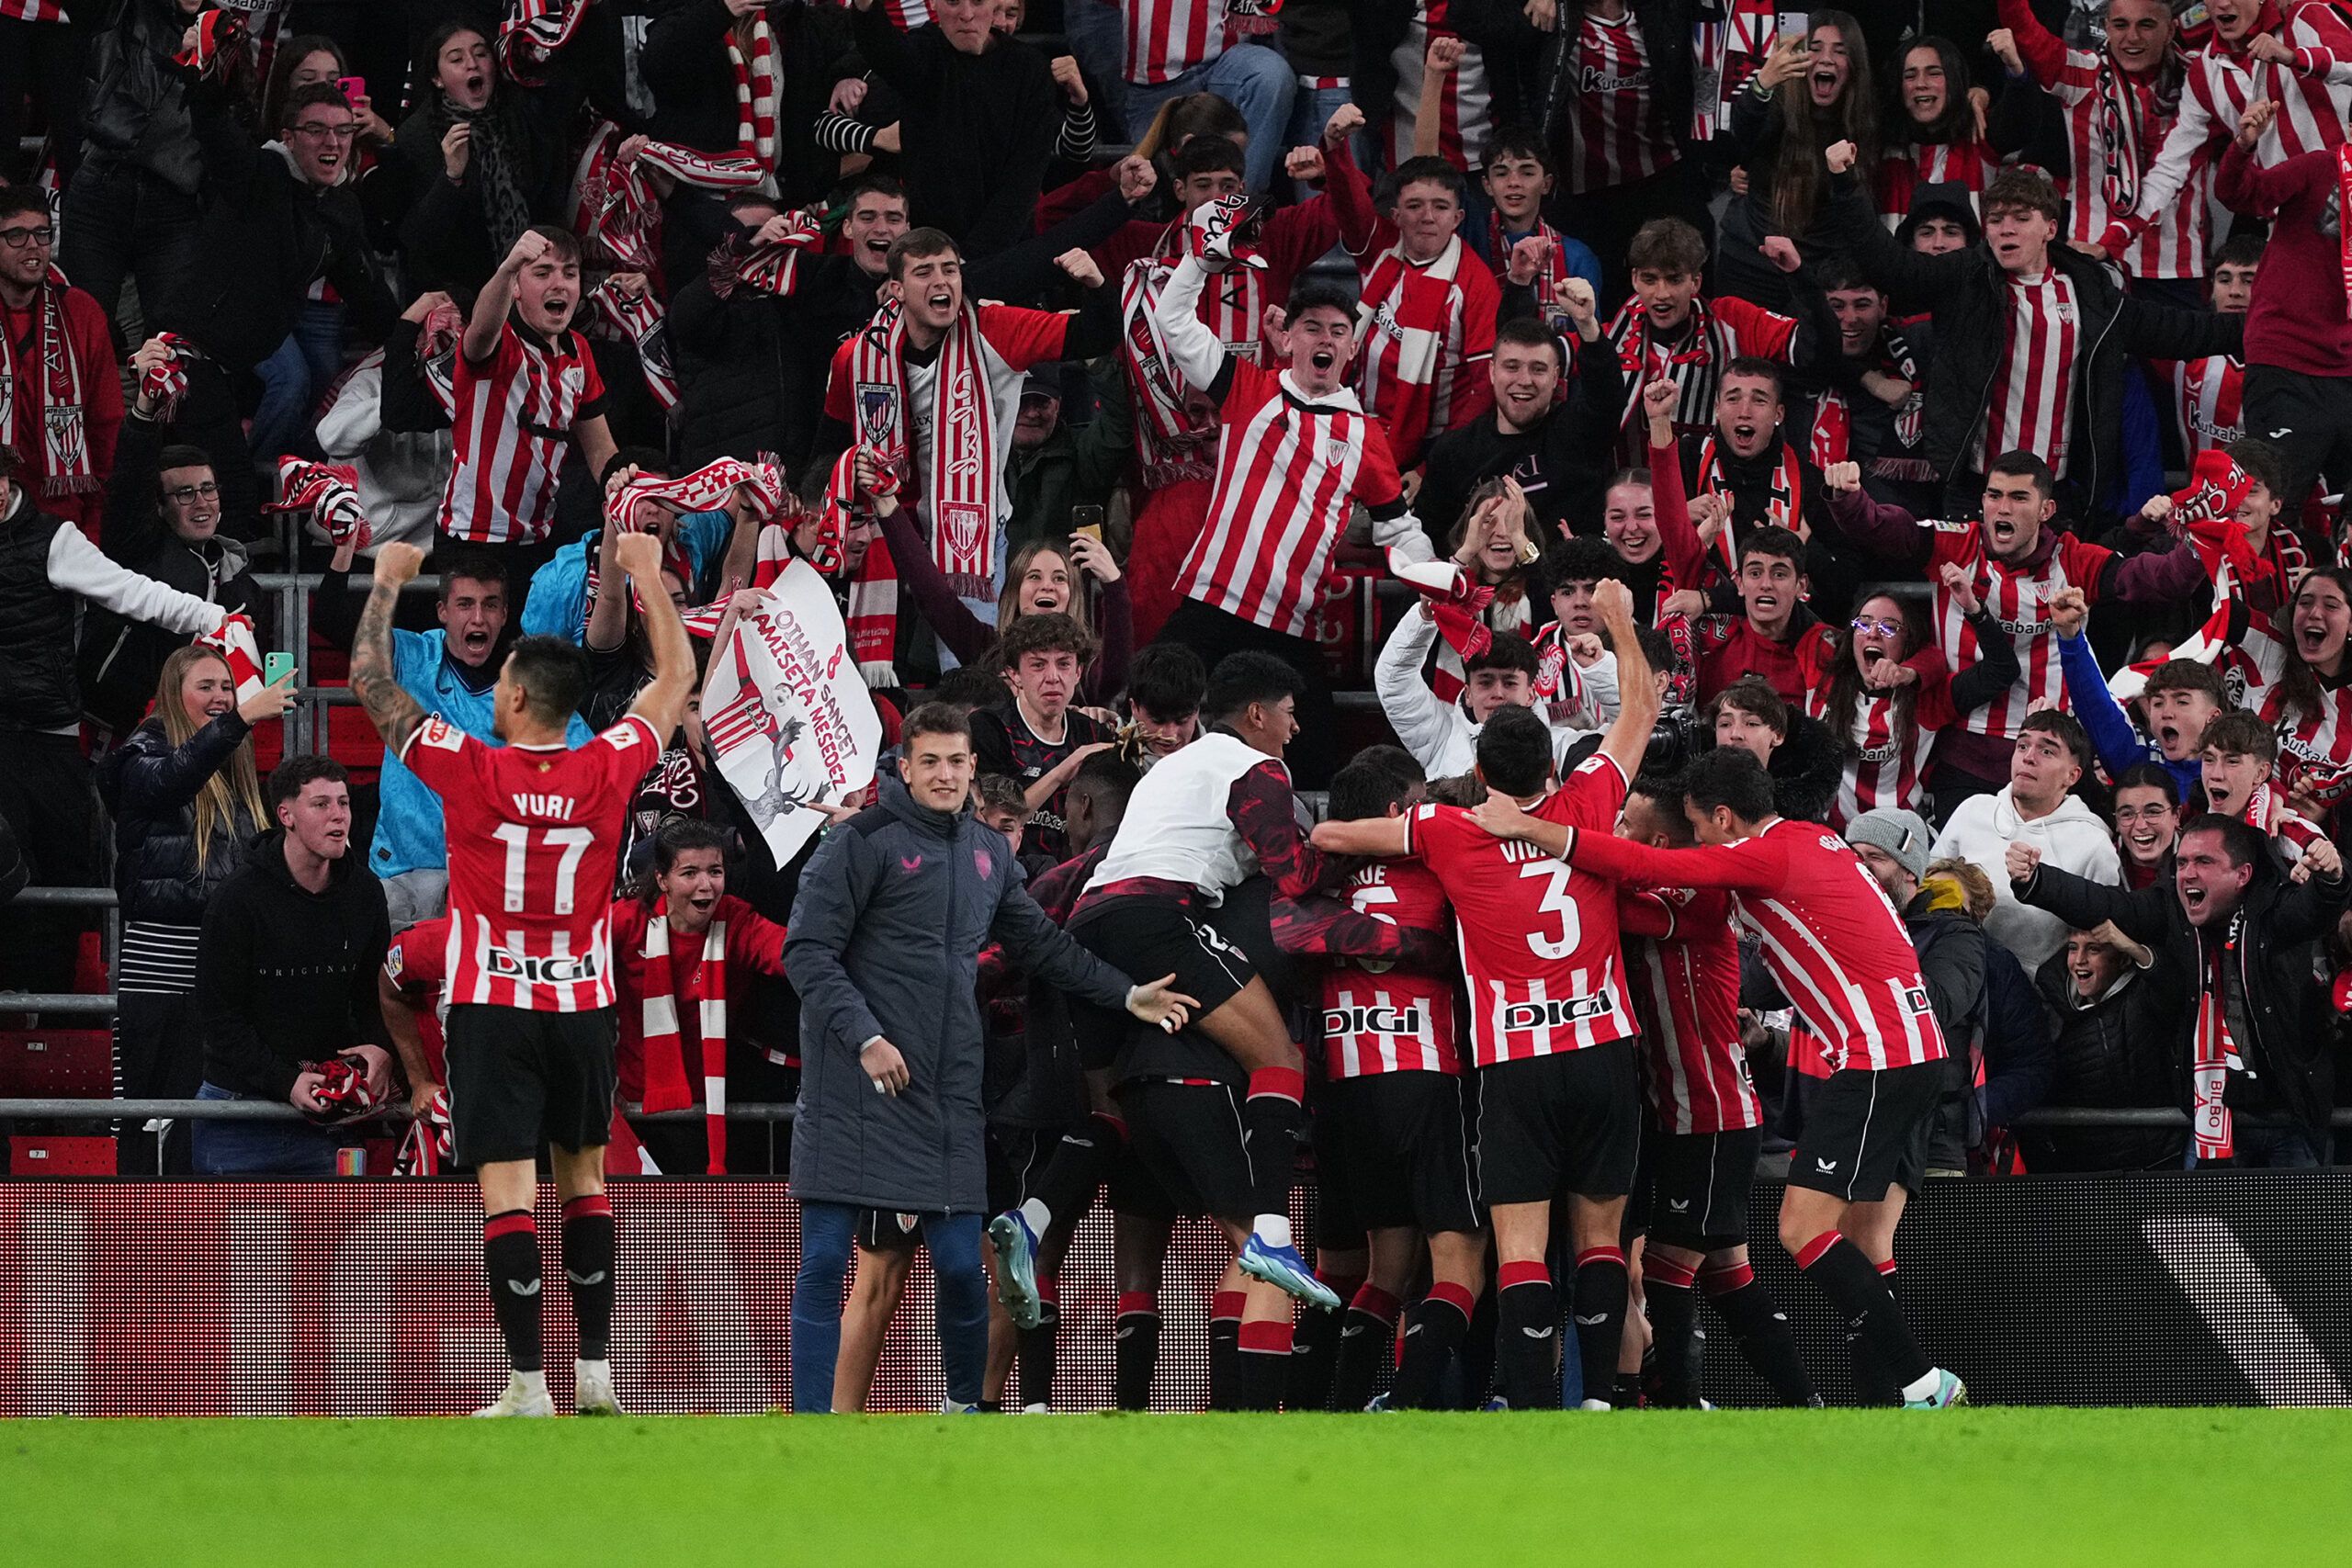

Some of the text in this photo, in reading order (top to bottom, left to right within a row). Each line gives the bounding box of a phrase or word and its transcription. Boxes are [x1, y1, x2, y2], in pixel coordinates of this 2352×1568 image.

[752, 604, 817, 707] AMISETA
[820, 683, 858, 760] SANCET
[513, 793, 575, 821] YURI
[492, 822, 596, 915] 17
[1519, 857, 1581, 960] 3
[487, 948, 596, 982] DIGI
[1323, 1008, 1420, 1036] DIGI
[1503, 988, 1613, 1031] DIGI
[2208, 1080, 2223, 1129] BILBO
